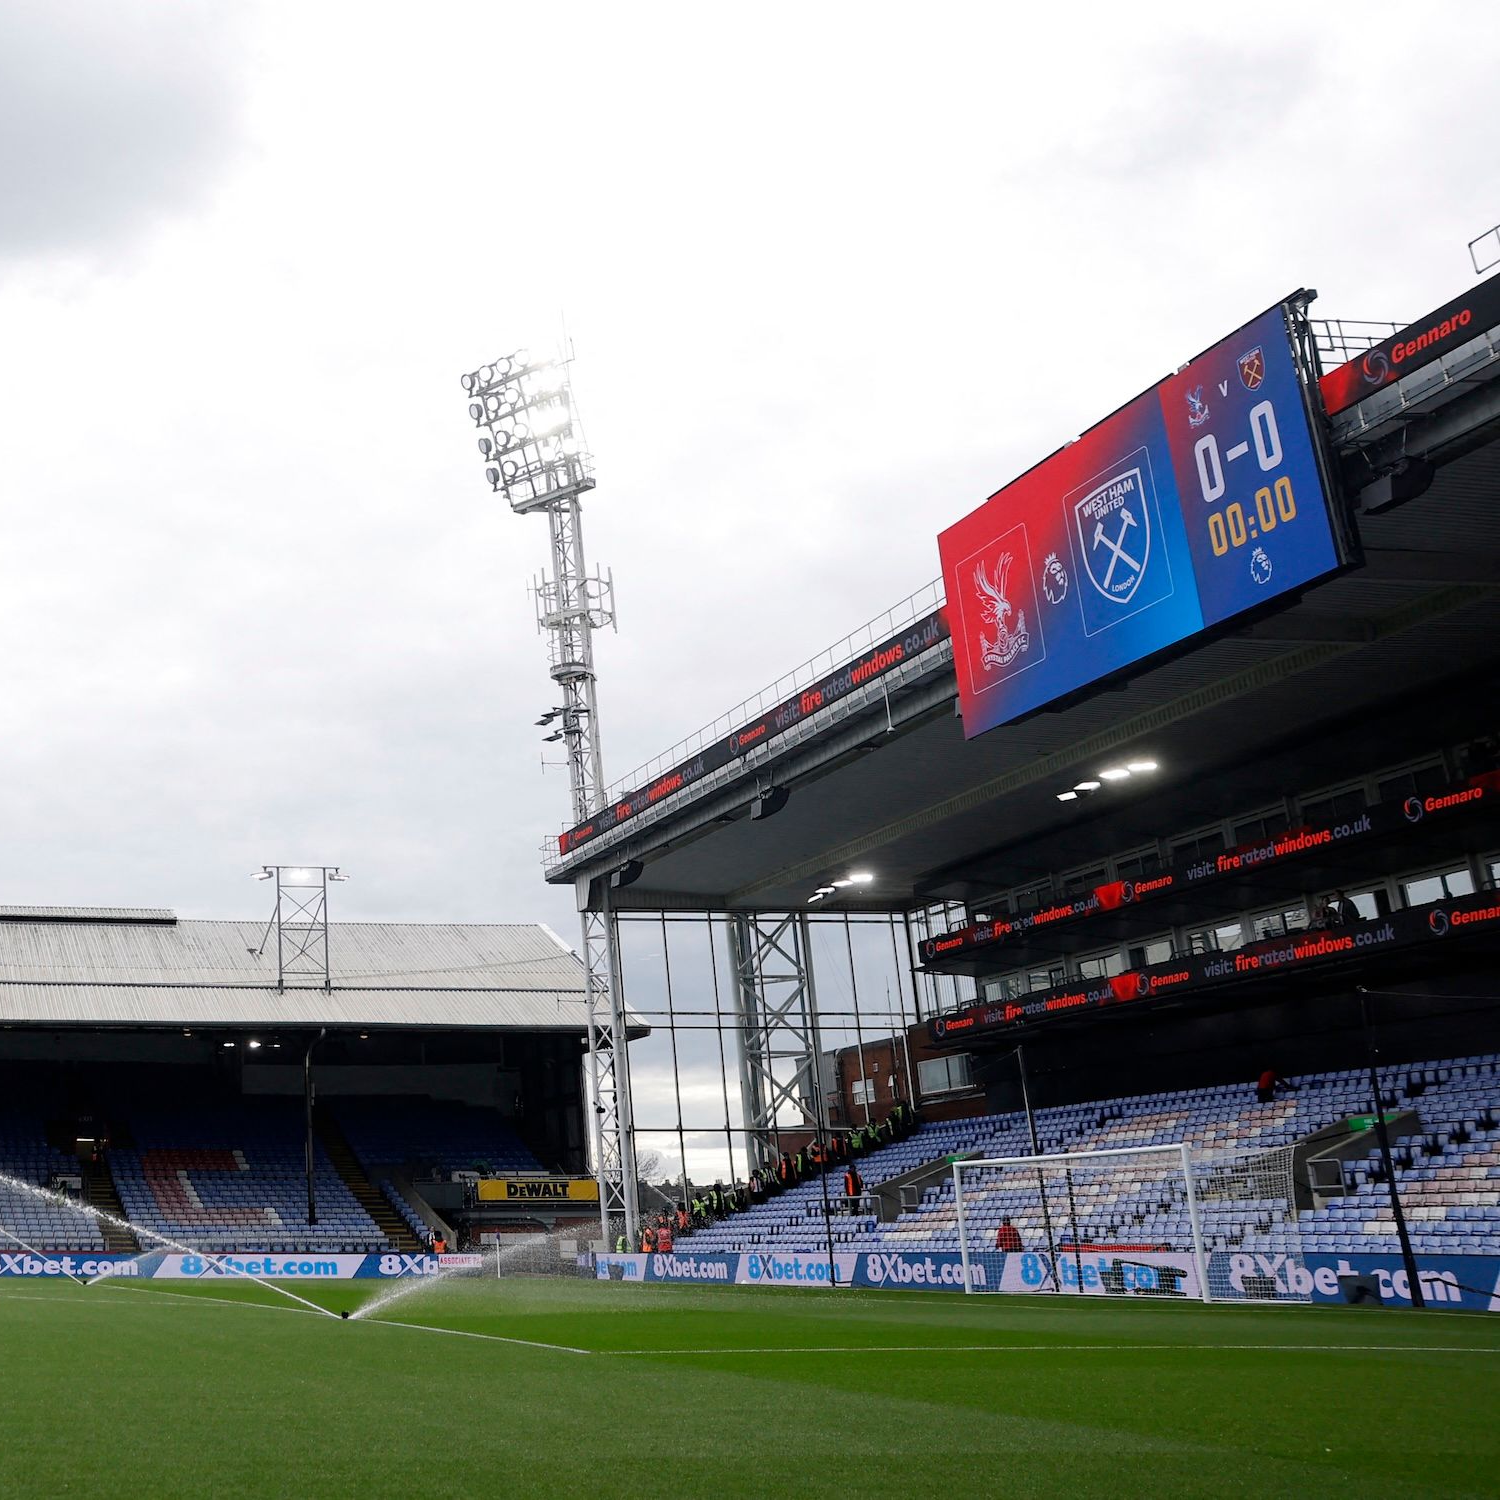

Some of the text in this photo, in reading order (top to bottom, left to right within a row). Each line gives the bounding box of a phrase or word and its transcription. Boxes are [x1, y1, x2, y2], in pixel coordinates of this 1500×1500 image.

[1391, 309, 1471, 364] Gennaro
[1194, 400, 1283, 502] 0-0
[1082, 478, 1135, 518] WEST HAM
[1094, 495, 1125, 520] UNITED
[1208, 476, 1297, 557] 00:00
[1111, 574, 1136, 592] LONDON
[738, 617, 939, 746] Gennaro visit: fireratedwindows.co.uk
[1425, 787, 1483, 812] Gennaro
[1187, 814, 1371, 881] visit: fireratedwindows.co.uk
[1135, 875, 1172, 894] Gennaro
[934, 936, 963, 952] Gennaro
[972, 926, 993, 942] visit:
[1204, 923, 1395, 978] visit: fireratedwindows.co.uk
[1151, 971, 1189, 988] Gennaro
[945, 1018, 974, 1031] Gennaro
[983, 1008, 1004, 1024] visit:
[180, 1255, 338, 1278] 8Xbet.com
[653, 1254, 728, 1280] 8Xbet.com
[748, 1254, 841, 1281] 8Xbet.com
[867, 1254, 986, 1288] 8Xbet.com
